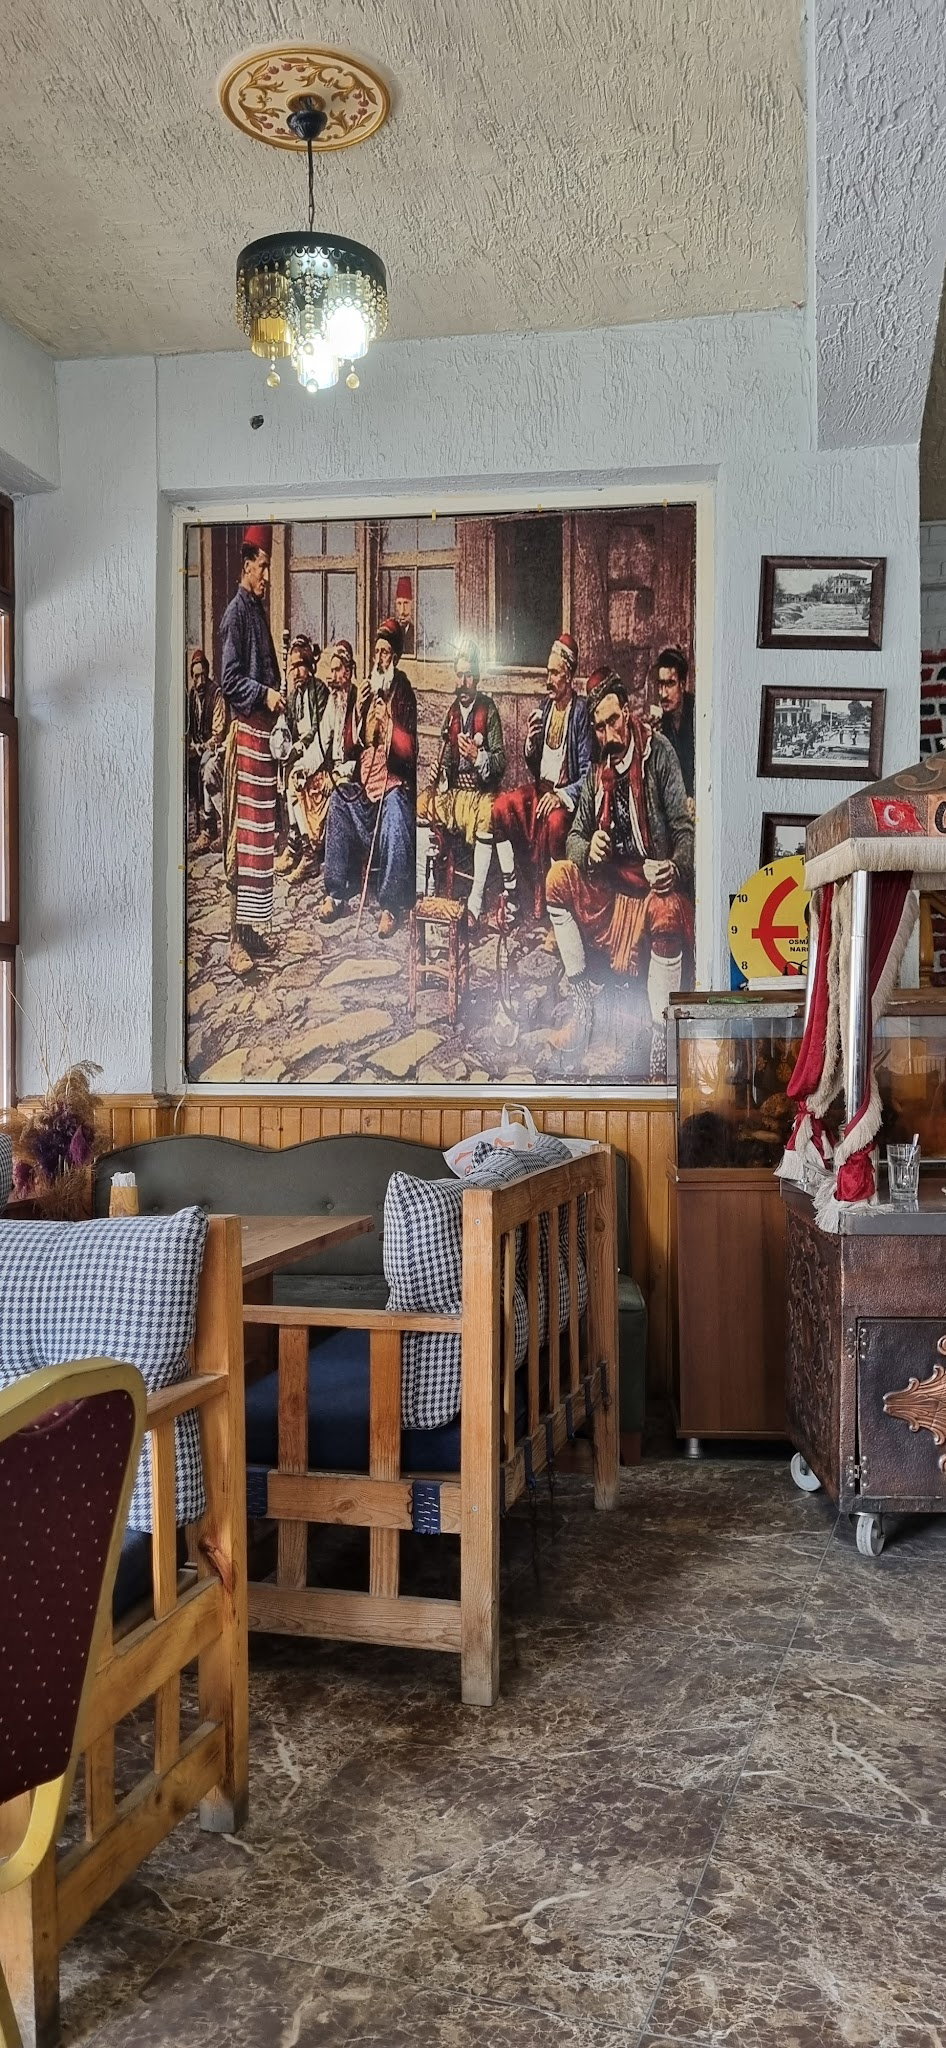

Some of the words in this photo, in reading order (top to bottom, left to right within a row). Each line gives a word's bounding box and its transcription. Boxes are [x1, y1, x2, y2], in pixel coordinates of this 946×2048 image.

[763, 867, 774, 876] 11
[736, 894, 748, 903] 10
[730, 925, 738, 934] 9
[741, 961, 748, 970] 8
